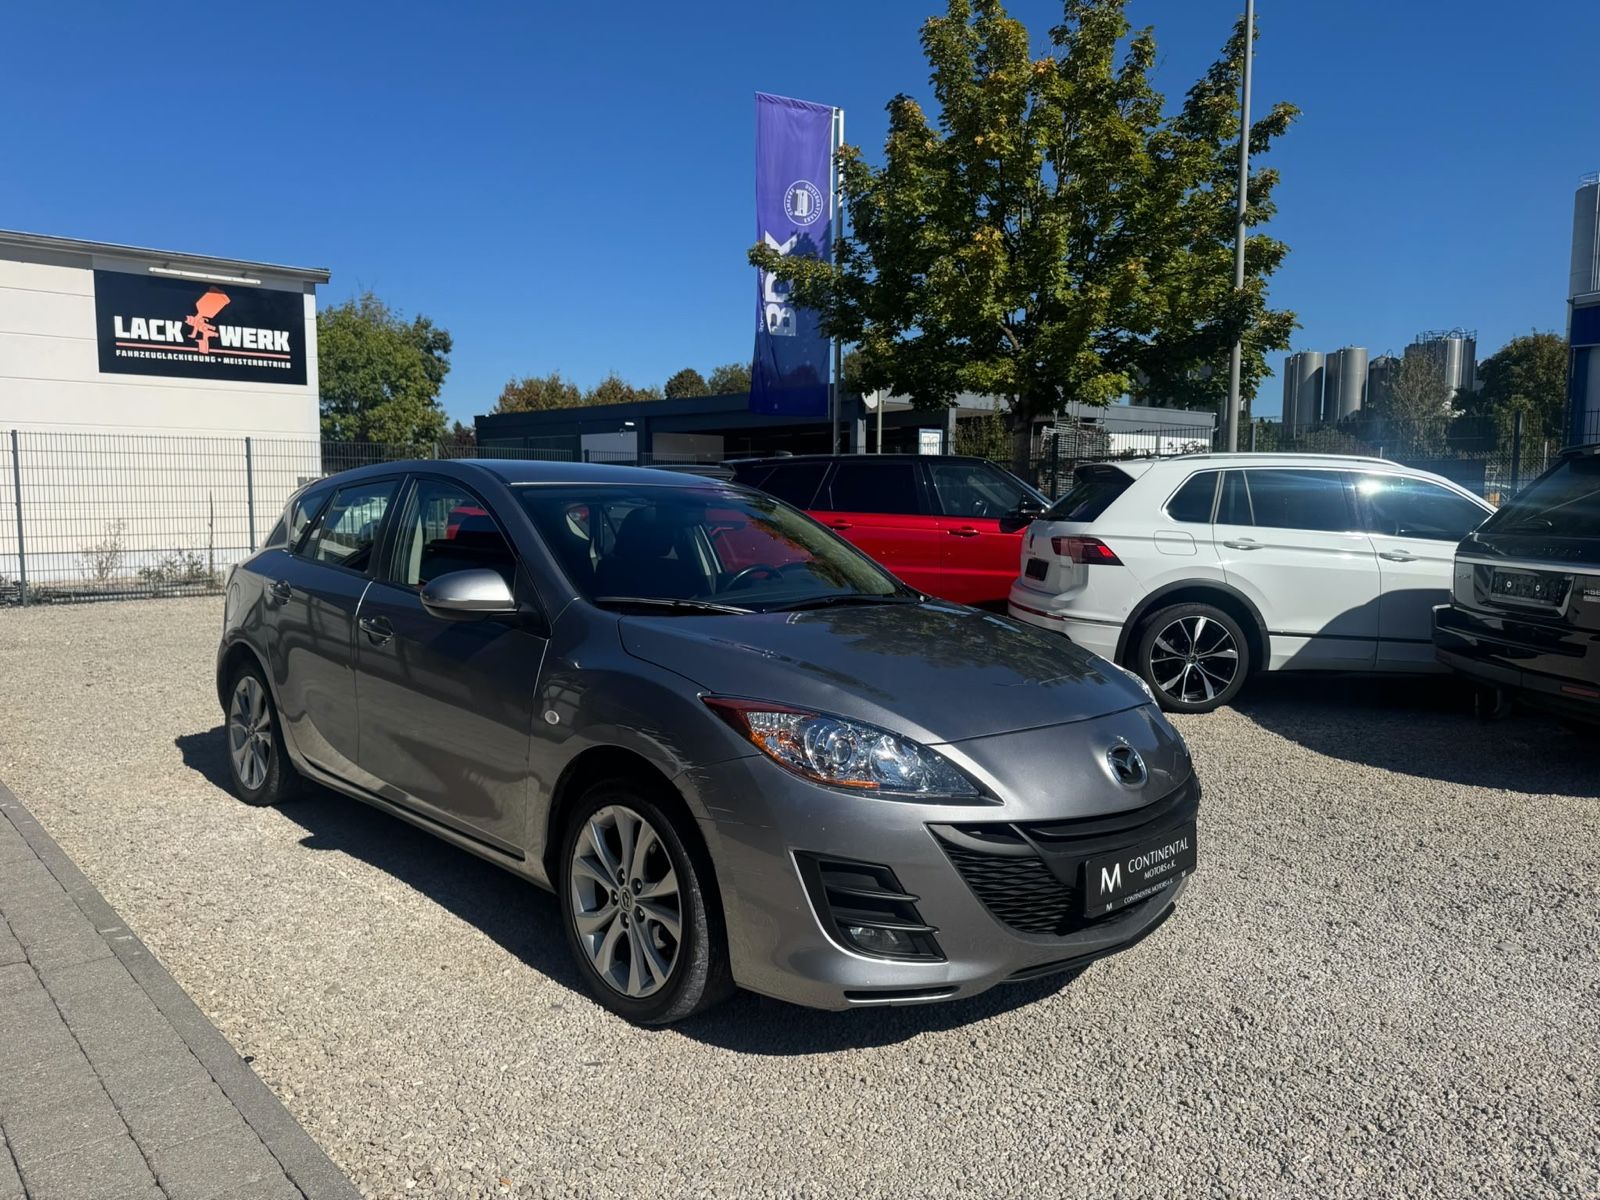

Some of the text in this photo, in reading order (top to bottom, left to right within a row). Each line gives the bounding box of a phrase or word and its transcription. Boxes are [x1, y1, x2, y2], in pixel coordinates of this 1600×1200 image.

[114, 315, 291, 352] LACK WERK
[115, 349, 291, 369] FAHRZEUGLACKIERUNG MEISTERBETRIEB
[1128, 837, 1188, 873] CONTINENTAL
[1144, 862, 1167, 880] MOTORS
[1100, 862, 1122, 896] M
